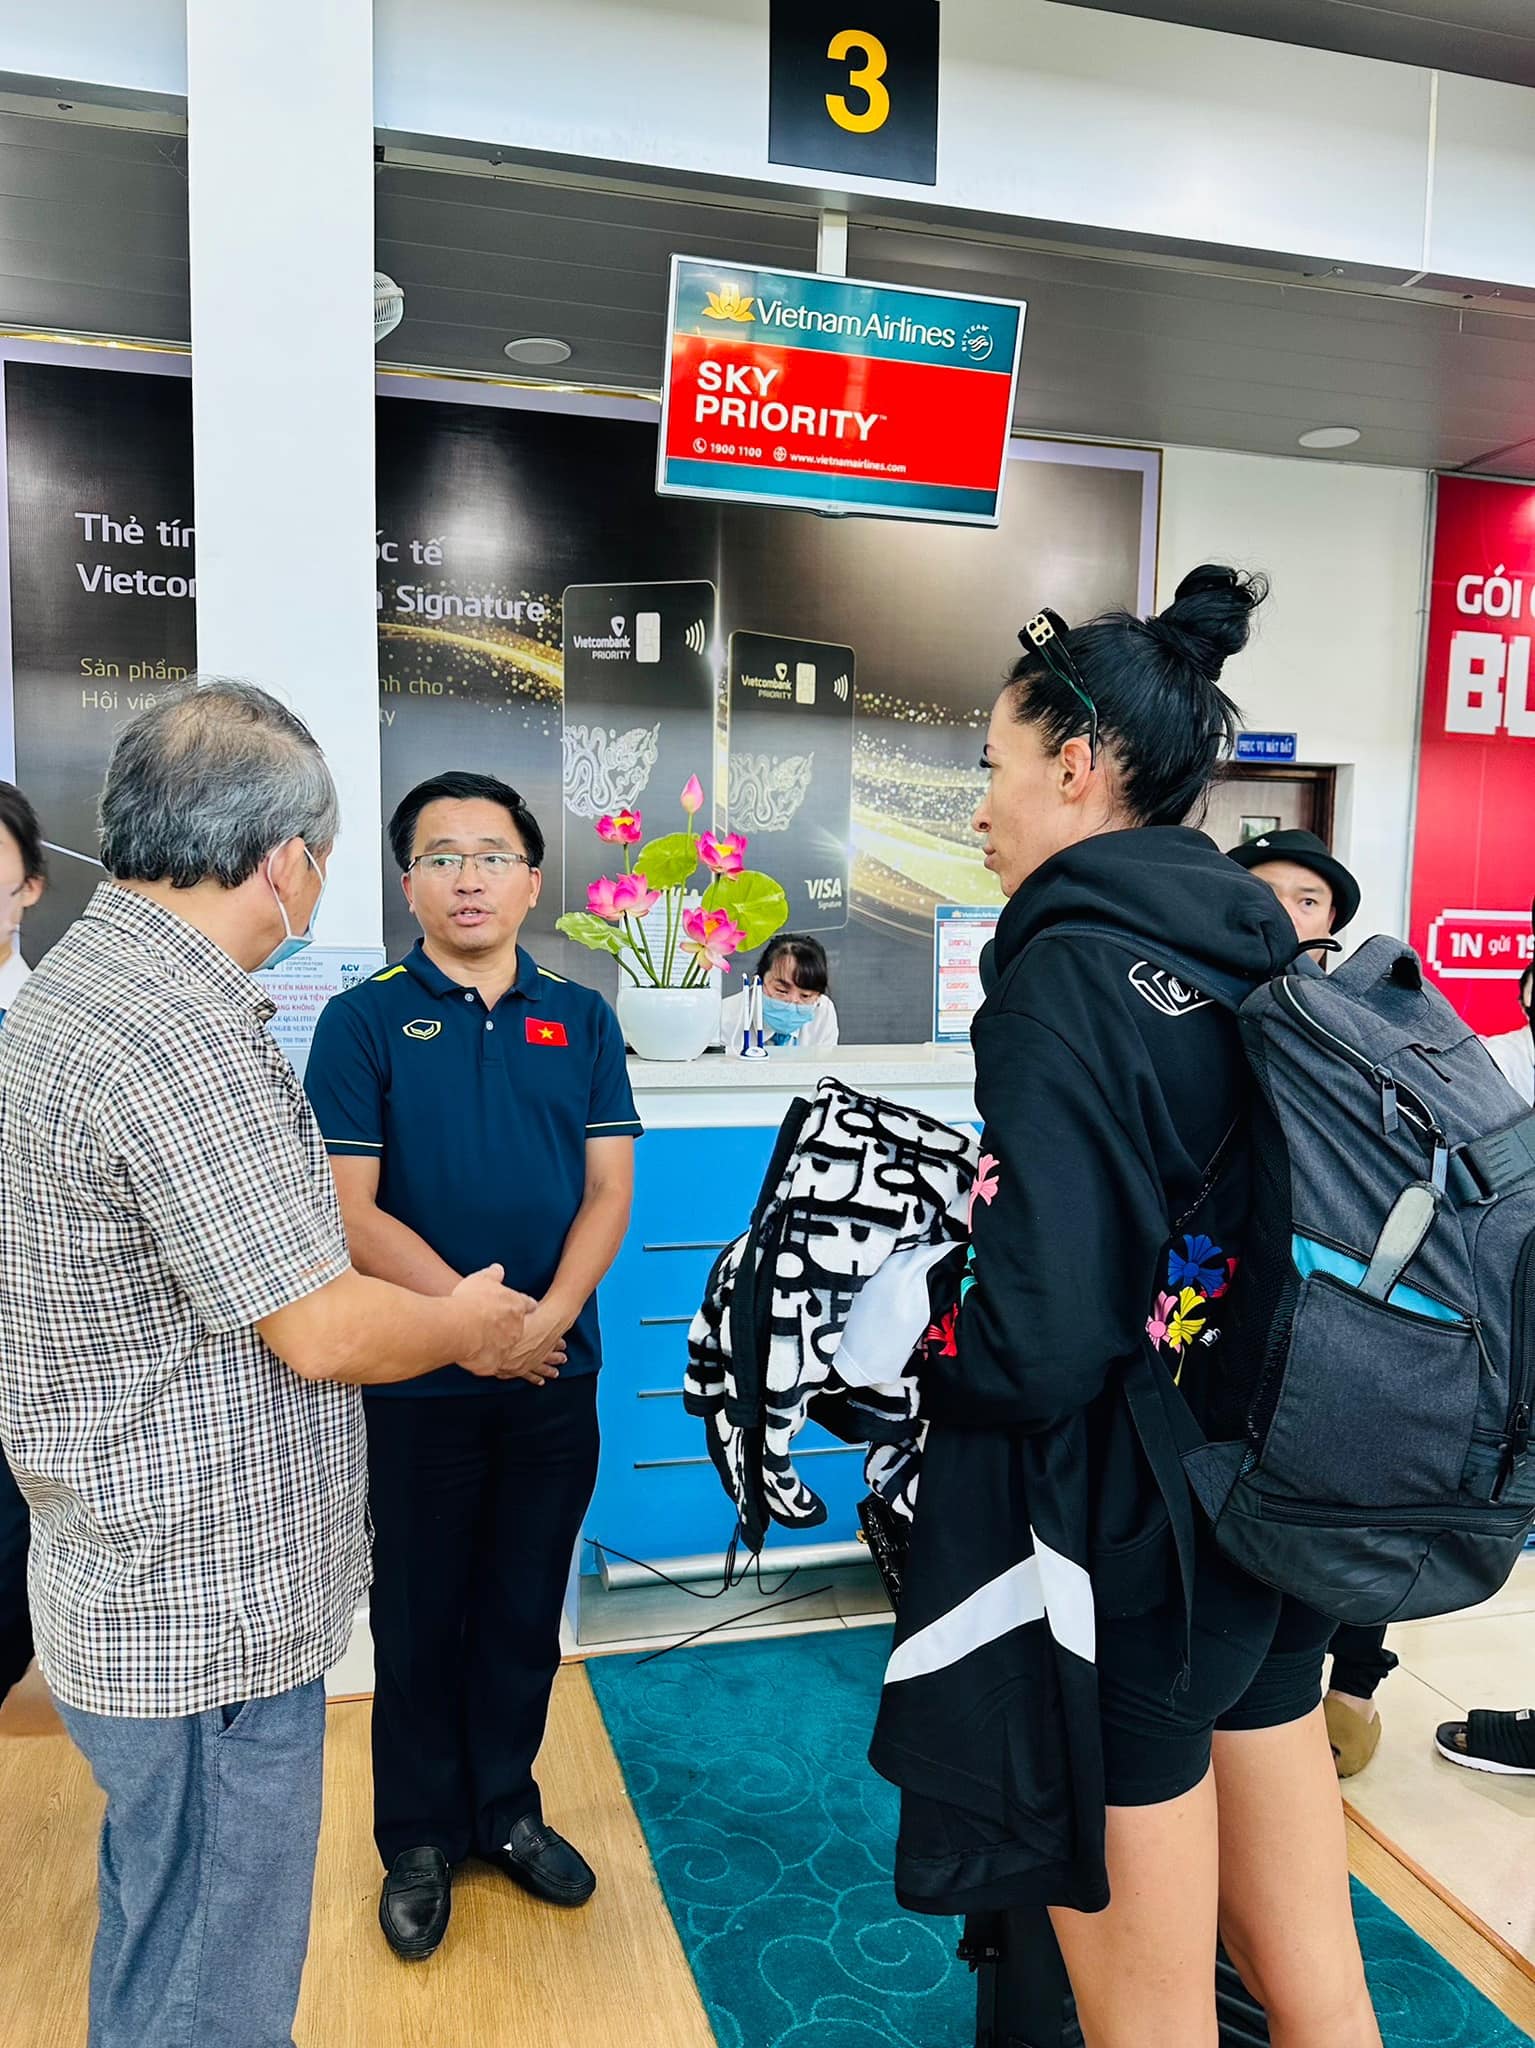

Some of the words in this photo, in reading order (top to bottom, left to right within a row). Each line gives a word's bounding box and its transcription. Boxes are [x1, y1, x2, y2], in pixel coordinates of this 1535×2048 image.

[825, 29, 891, 134] 3
[756, 297, 861, 338] Vietnam
[862, 313, 956, 349] Airlines
[696, 360, 780, 397] SKY
[694, 394, 879, 442] PRIORITY
[710, 442, 735, 455] 1900
[739, 445, 762, 458] 1100
[790, 452, 907, 473] www.vietnamairlines.com
[74, 511, 144, 545] Thẻ
[410, 536, 446, 566] tế
[75, 563, 196, 598] Vietco
[1456, 563, 1523, 618] GÓI
[396, 584, 546, 622] Signature
[573, 635, 631, 649] Vietcombank
[591, 650, 631, 660] PRIORITY
[80, 658, 119, 677] Sản
[129, 657, 187, 683] phẩm
[740, 674, 792, 691] Vietcombank
[409, 676, 444, 696] cho
[758, 689, 792, 701] PRIORITY
[81, 690, 118, 712] Hội
[804, 878, 842, 900] VISA
[1449, 932, 1483, 958] 1N
[1487, 934, 1512, 956] gửi
[340, 963, 360, 972] ACV
